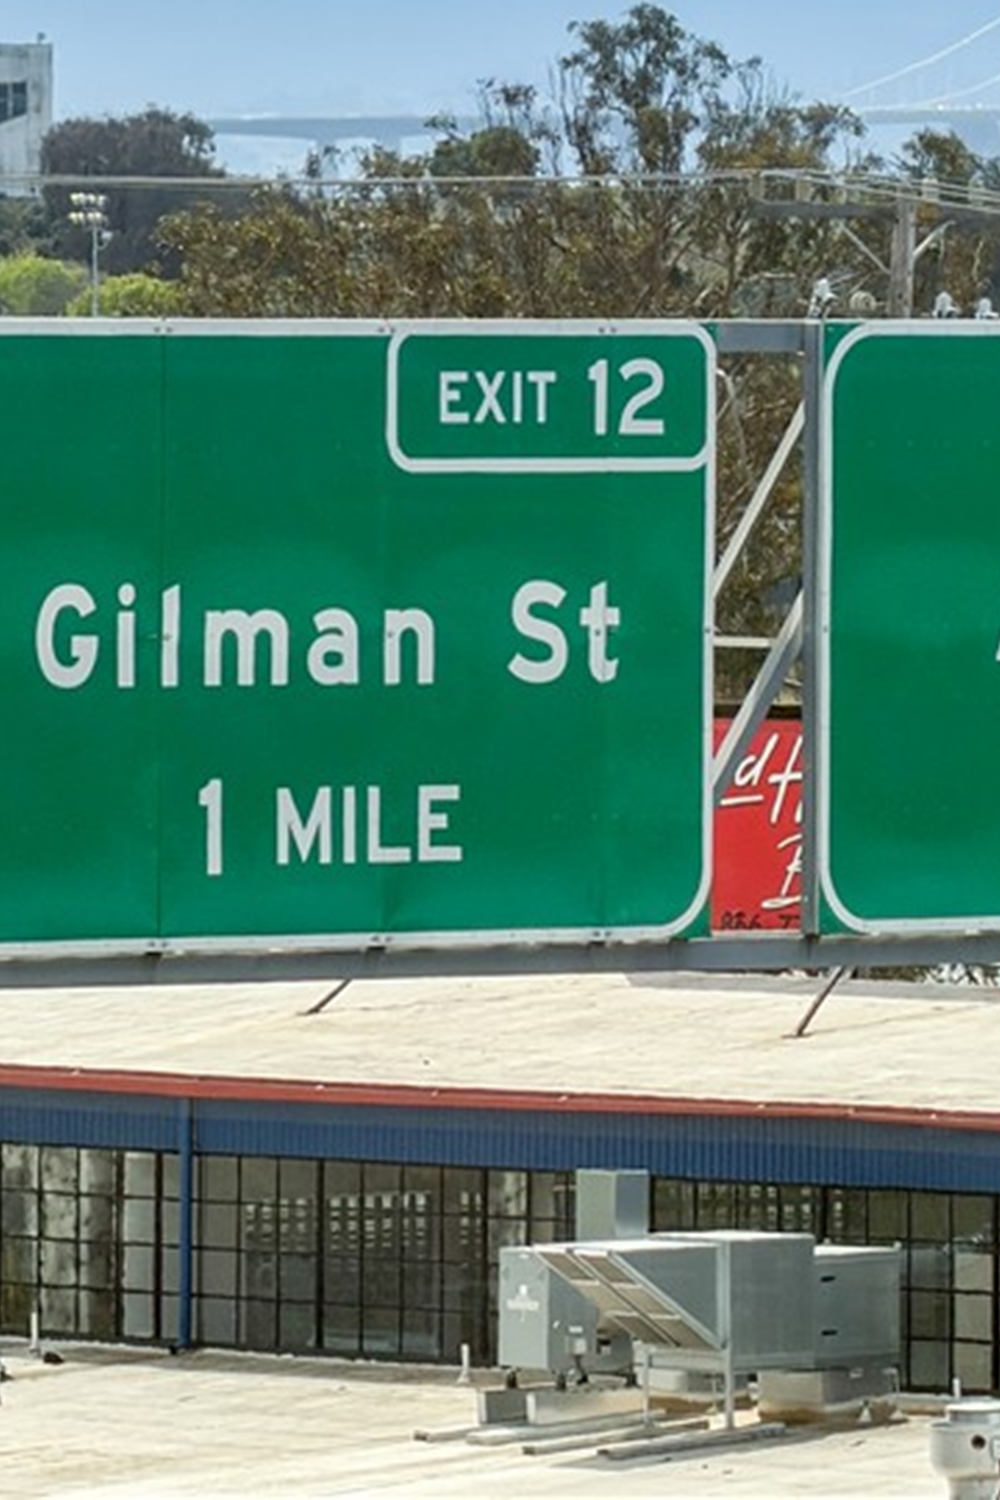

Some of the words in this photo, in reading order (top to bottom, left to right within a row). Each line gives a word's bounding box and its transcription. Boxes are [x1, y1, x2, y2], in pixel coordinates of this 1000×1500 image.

[439, 371, 556, 423] EXIT
[588, 358, 665, 435] 12
[35, 583, 435, 688] Gilman
[507, 580, 620, 683] St
[198, 778, 223, 876] 1
[276, 785, 463, 864] MILE
